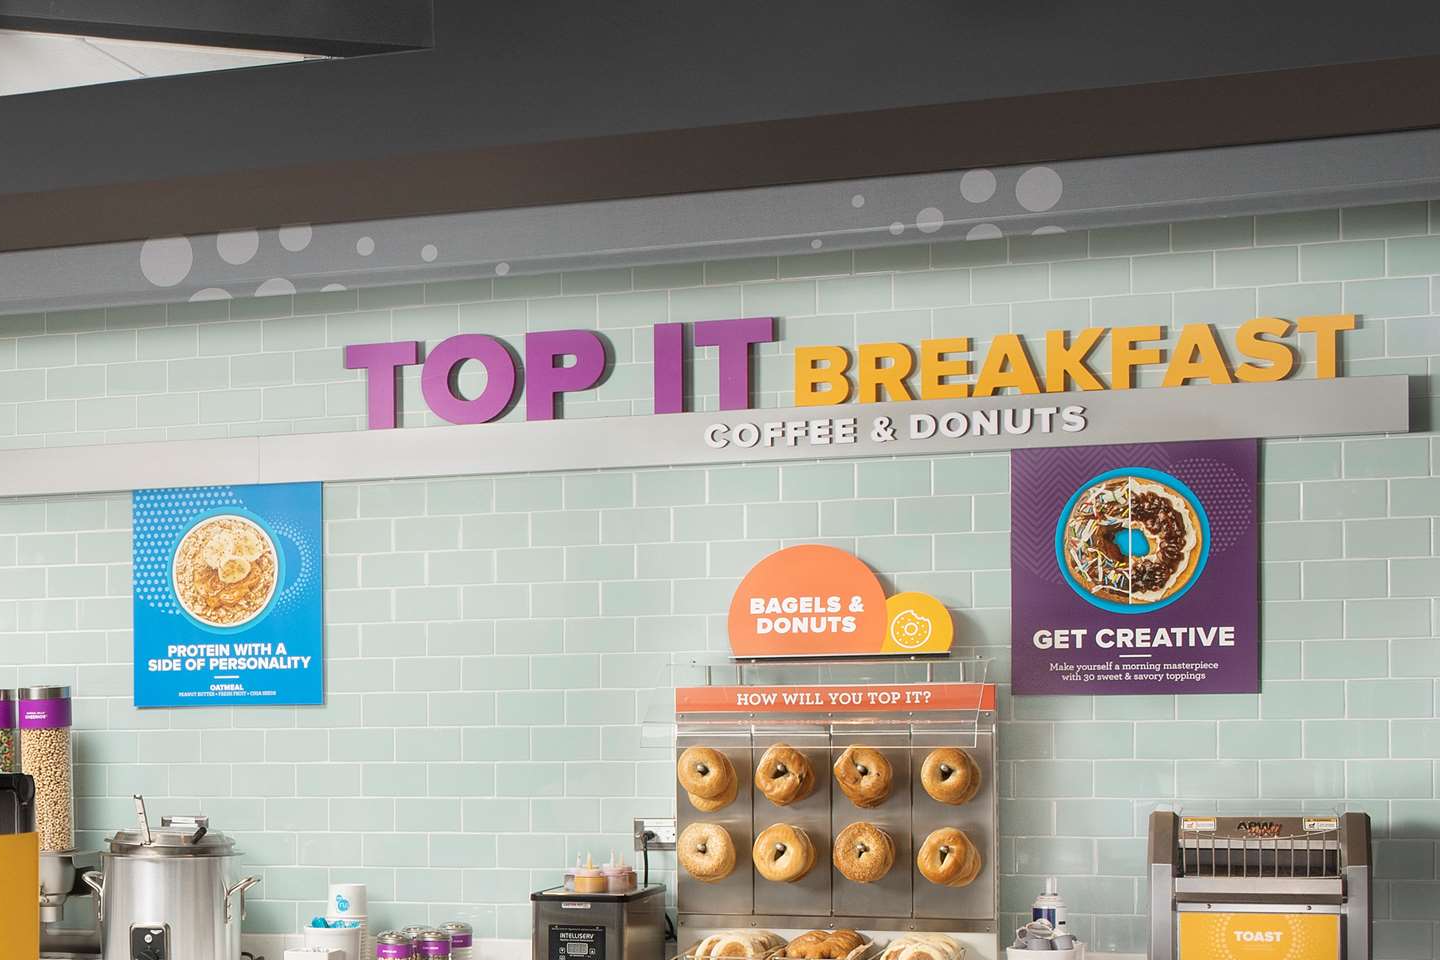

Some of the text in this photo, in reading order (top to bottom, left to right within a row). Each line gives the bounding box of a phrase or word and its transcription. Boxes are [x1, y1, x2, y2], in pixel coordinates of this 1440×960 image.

[346, 314, 1359, 430] TOP IT BREAKFAST
[704, 406, 1089, 449] COFFEE & DONUTS
[750, 595, 864, 614] BAGELS &
[756, 616, 856, 634] DONUTS
[1033, 627, 1235, 649] GET CREATIVE
[168, 643, 287, 657] PROTEIN WITH A
[148, 656, 311, 672] SIDE OF PERSONALITY
[1049, 663, 1074, 671] Make
[1076, 662, 1113, 673] yourself
[1122, 662, 1161, 672] morning
[1163, 661, 1219, 672] masterpiece
[1062, 671, 1206, 683] with 30 sweet & savory toppings
[736, 691, 932, 705] HOW WILL YOU TOP IT?
[1233, 931, 1284, 943] TOAST
